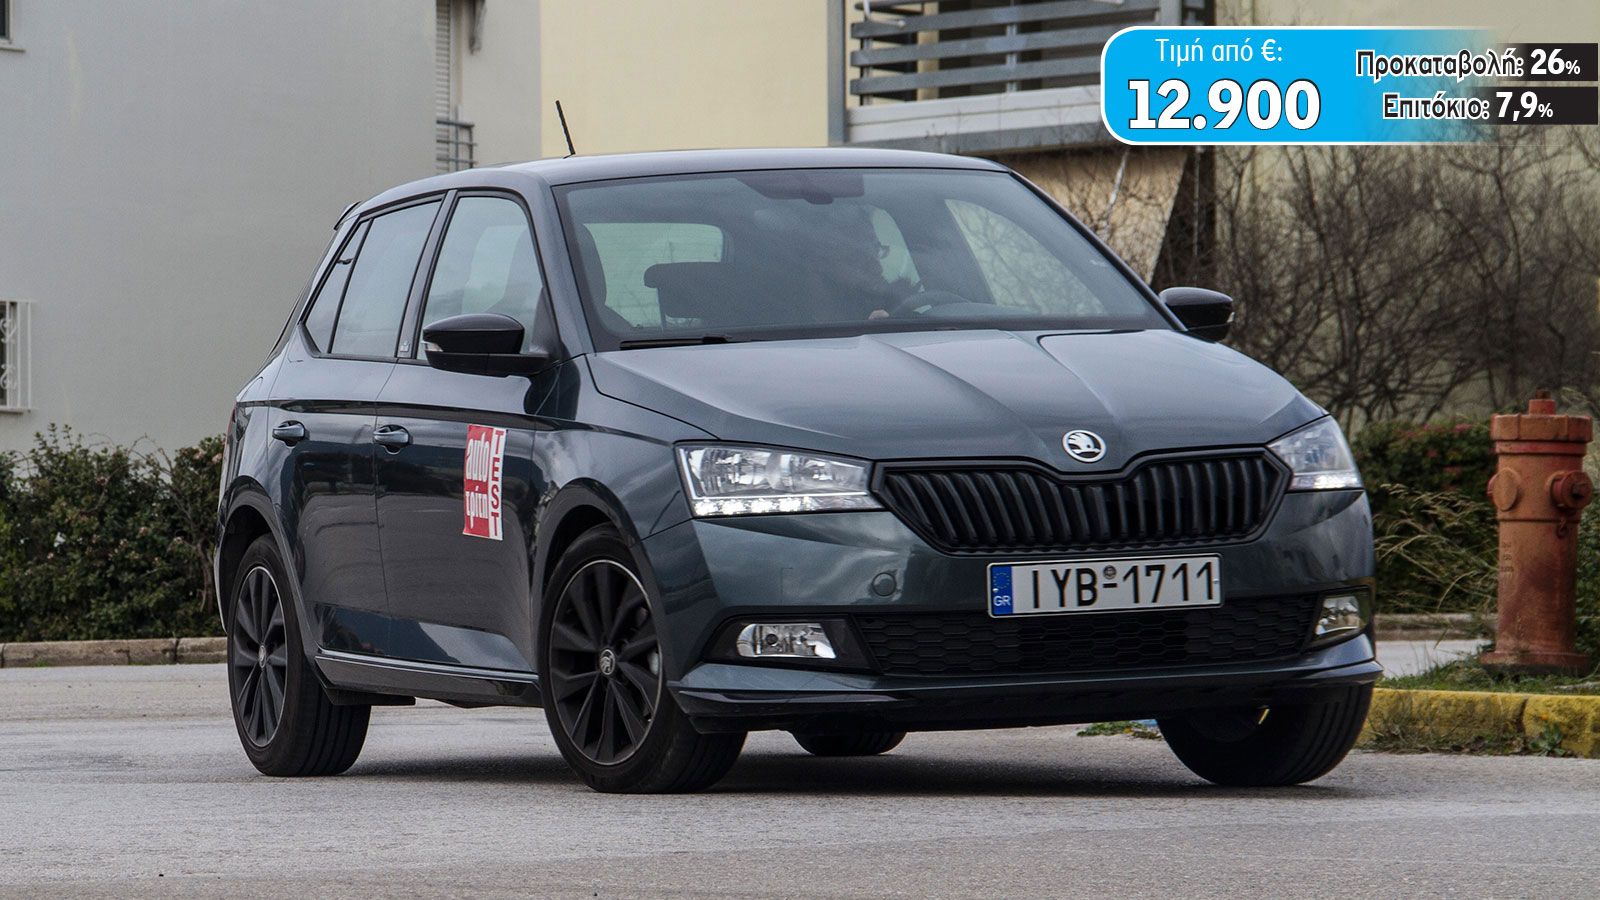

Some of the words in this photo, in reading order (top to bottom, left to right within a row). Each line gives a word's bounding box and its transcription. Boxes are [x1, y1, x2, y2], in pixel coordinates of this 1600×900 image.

[465, 431, 490, 482] auto
[491, 429, 505, 537] TEST
[993, 595, 1011, 607] GR
